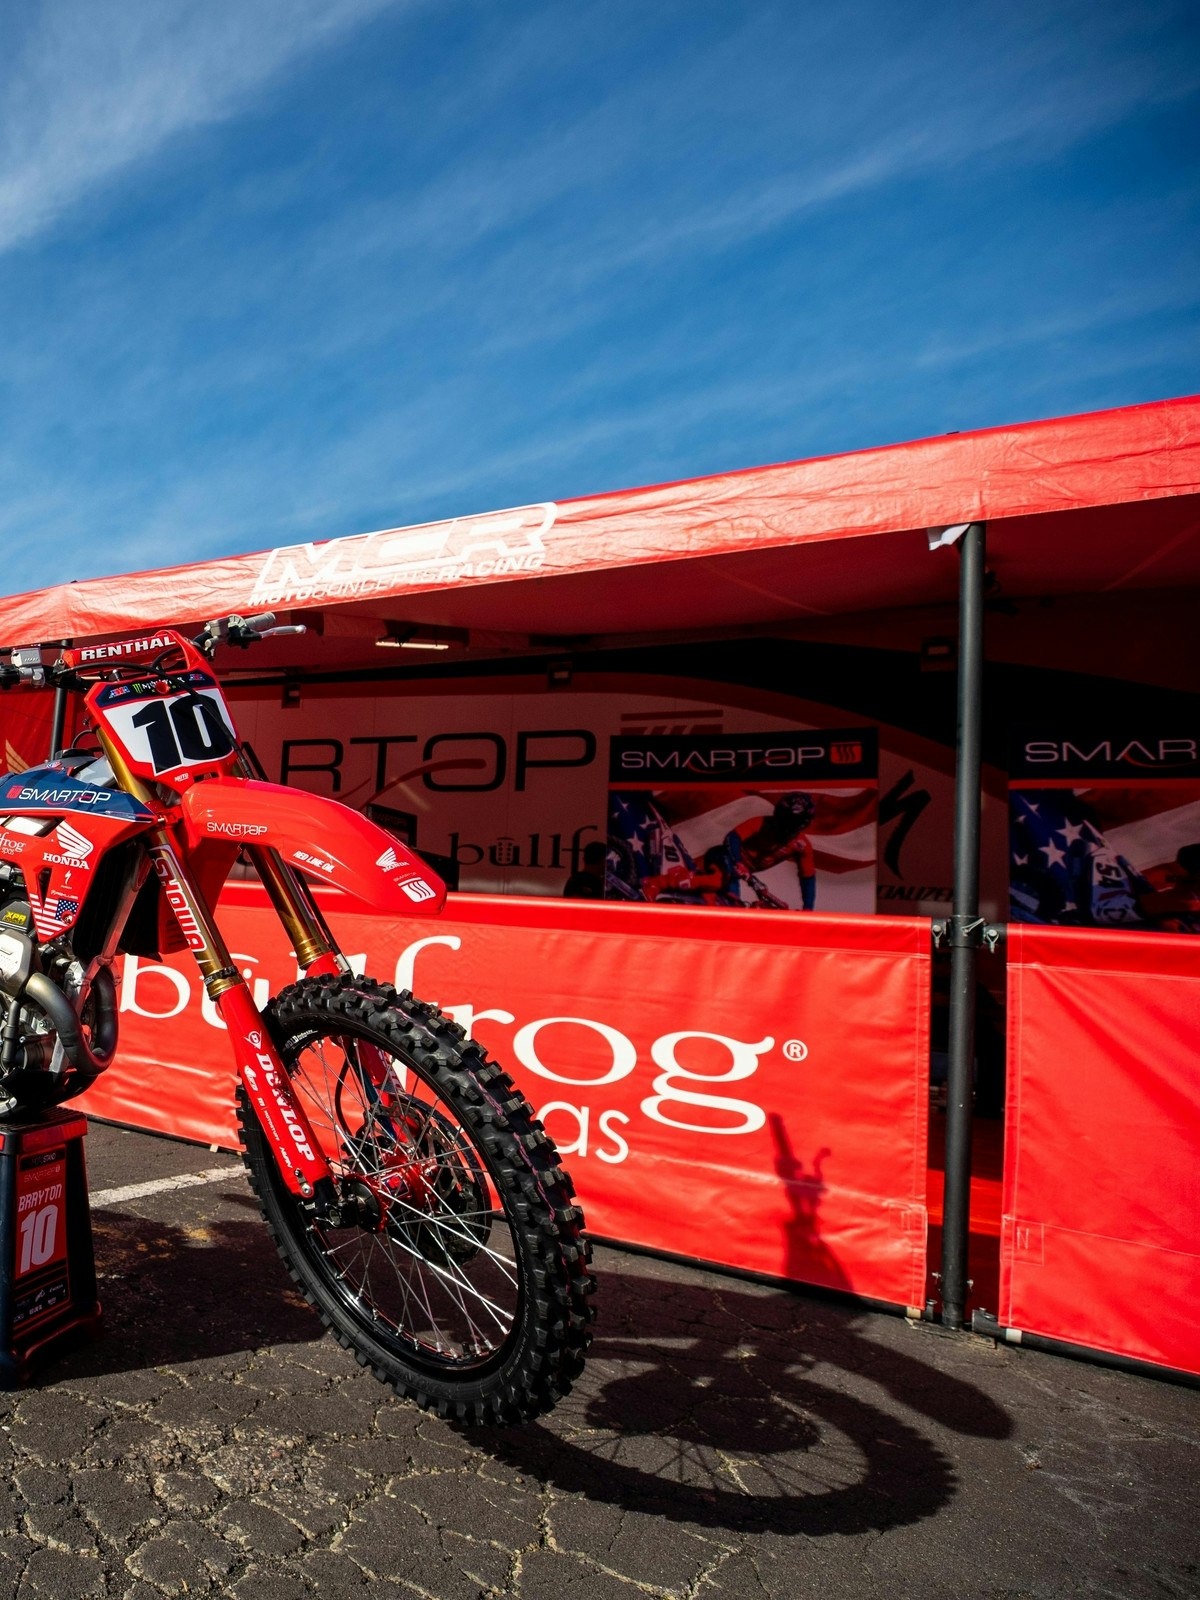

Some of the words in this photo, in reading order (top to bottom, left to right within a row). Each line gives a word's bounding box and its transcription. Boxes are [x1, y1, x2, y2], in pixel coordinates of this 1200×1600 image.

[252, 501, 558, 594] MCR
[81, 635, 177, 661] RENTHAL
[131, 694, 234, 774] 10
[241, 729, 597, 793] RTOP
[620, 745, 827, 772] SMARTOP
[1024, 739, 1199, 763] SMAR
[18, 787, 112, 806] SMARTOP
[206, 822, 268, 838] SMARTOP
[43, 852, 90, 870] HONDA
[448, 825, 599, 870] bullf
[293, 850, 308, 862] RED
[308, 855, 323, 867] LINE
[322, 860, 335, 873] OIL
[17, 1183, 62, 1213] BRAYTON
[20, 1204, 59, 1274] 10
